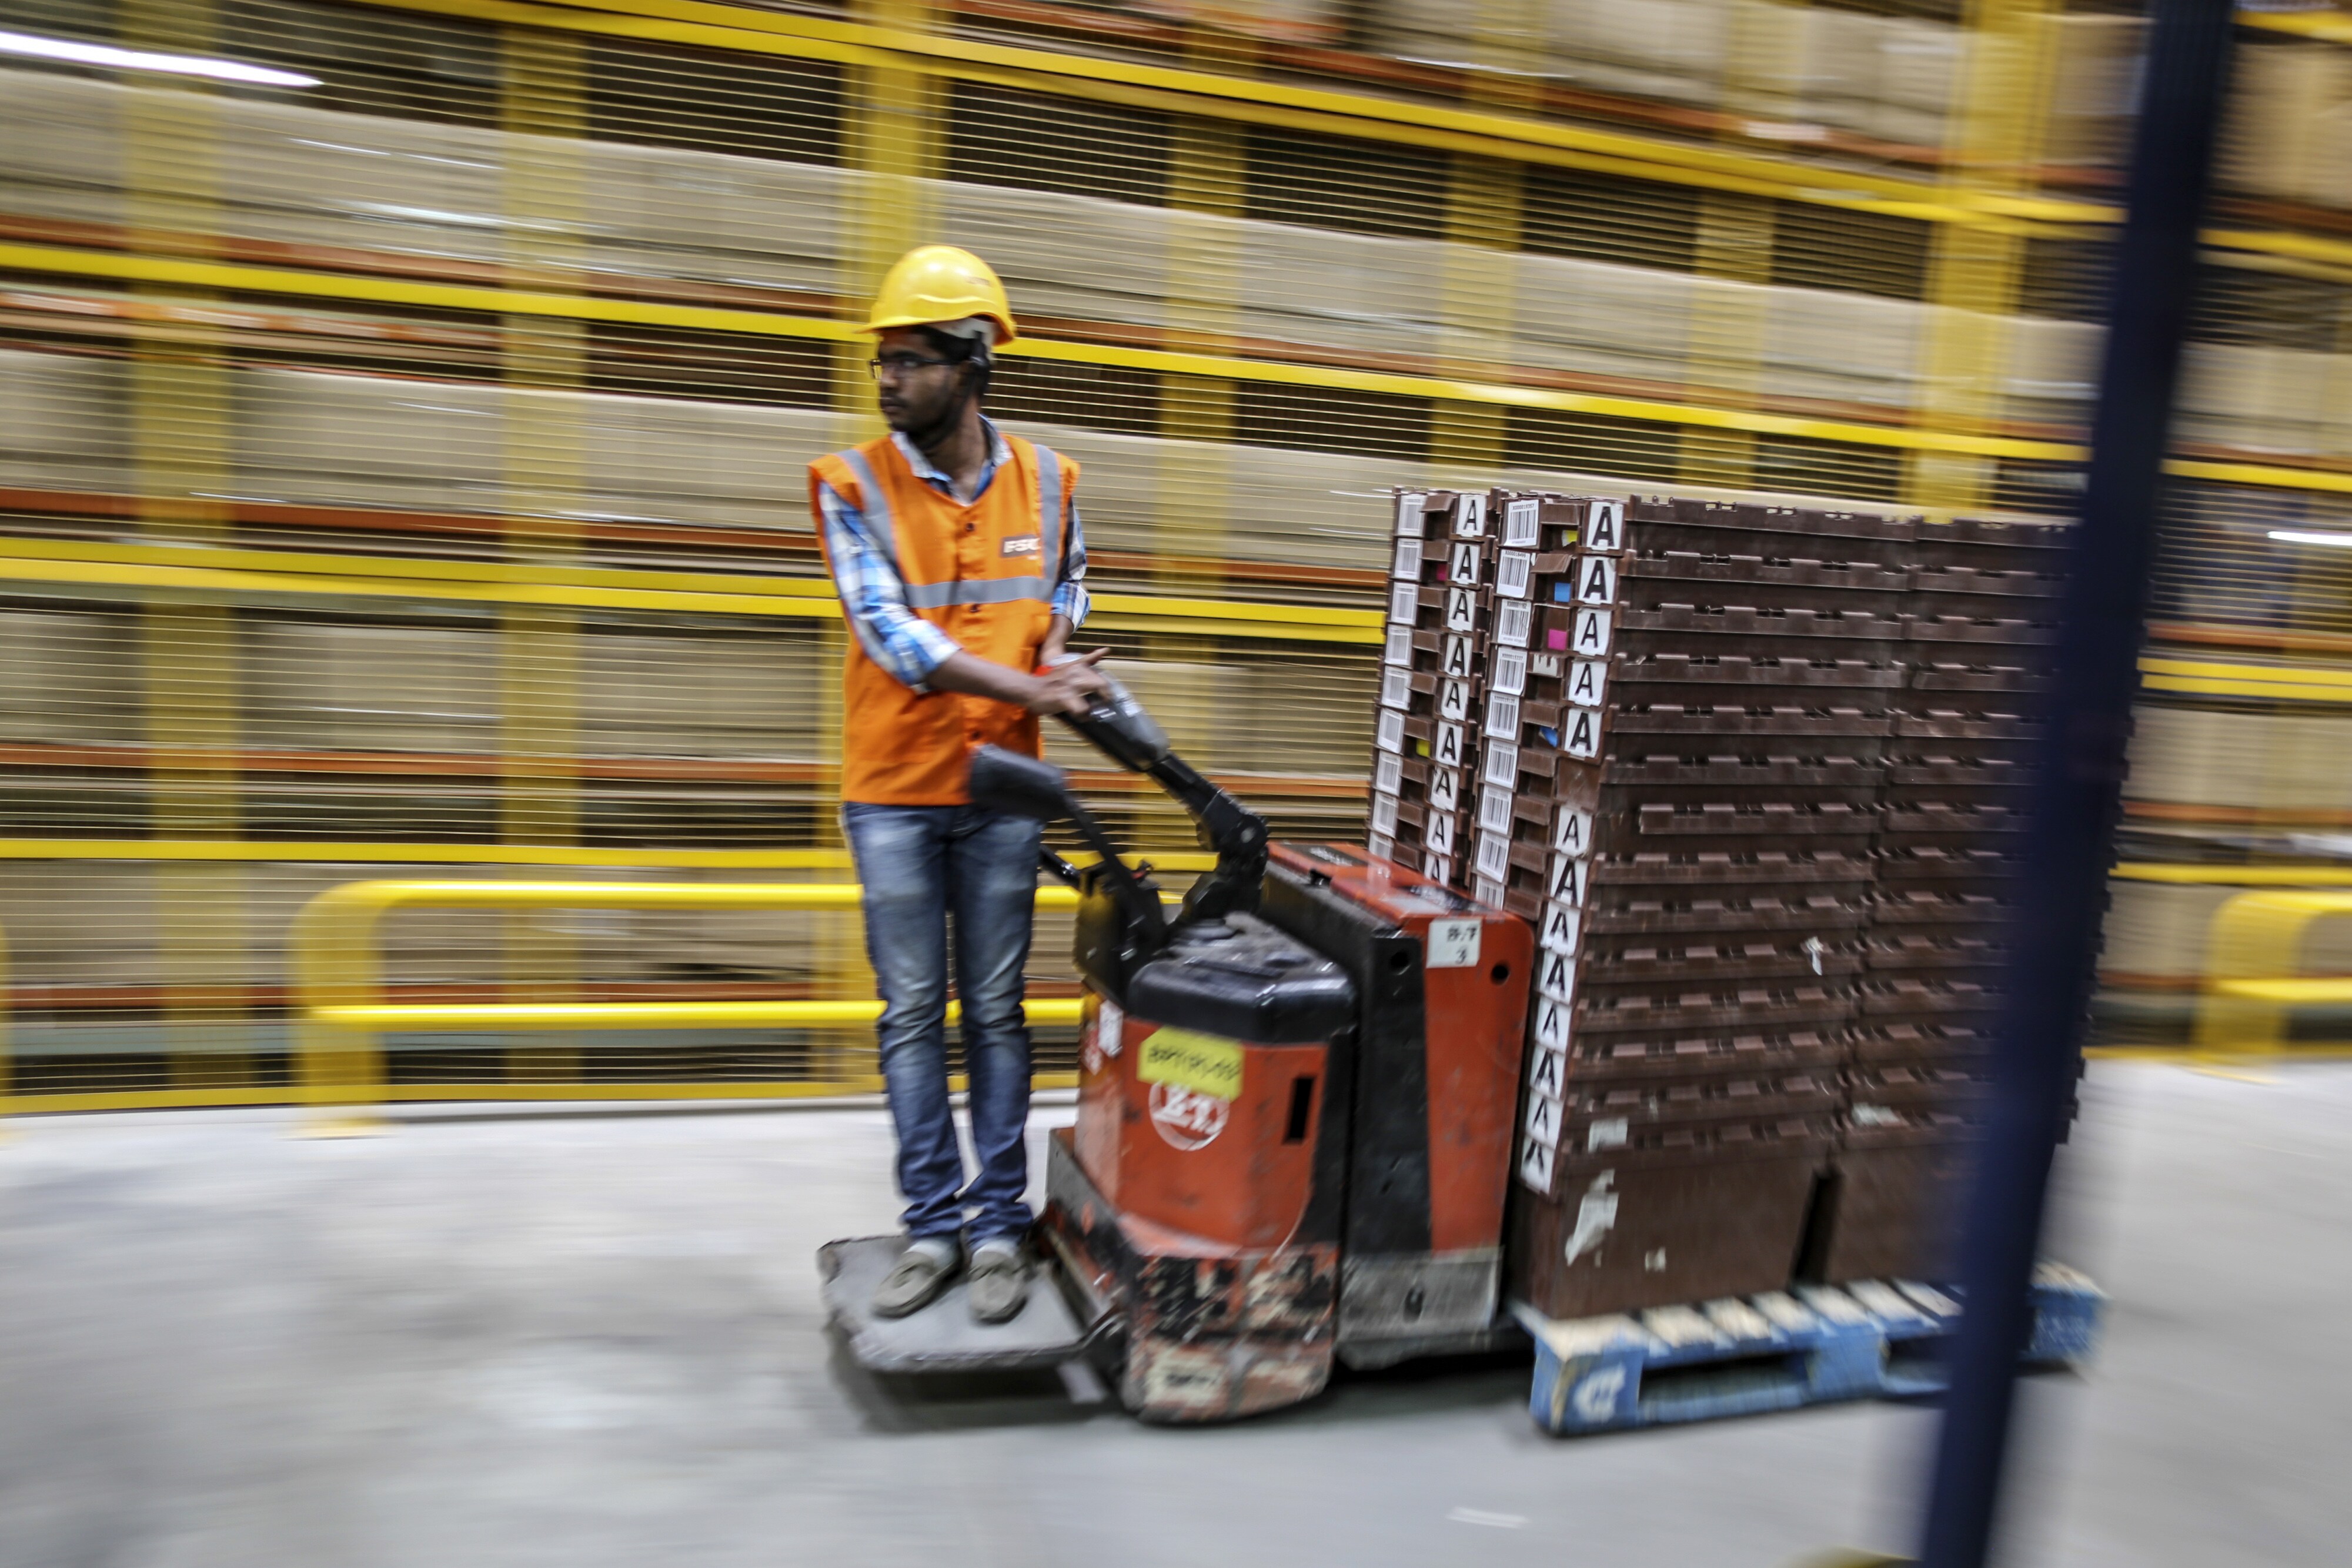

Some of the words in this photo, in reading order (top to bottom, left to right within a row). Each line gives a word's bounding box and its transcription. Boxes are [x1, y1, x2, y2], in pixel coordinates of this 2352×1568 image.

[1464, 500, 1477, 531] A
[1592, 506, 1614, 547] A
[1458, 545, 1472, 580] A
[1583, 559, 1607, 600] A
[1453, 592, 1469, 622] A
[1581, 613, 1598, 647] A
[1449, 637, 1465, 676] A
[1446, 682, 1461, 710] A
[1575, 663, 1593, 698] A
[1441, 726, 1456, 761] A
[1570, 711, 1592, 751] A
[1435, 770, 1453, 799] A
[1432, 815, 1445, 846] A
[1563, 814, 1579, 849] A
[1431, 858, 1440, 882] A
[1555, 858, 1578, 907] A
[1550, 908, 1568, 942] A
[1546, 955, 1566, 997] A
[1542, 1003, 1558, 1042] A
[1535, 1048, 1556, 1095] A
[1533, 1096, 1548, 1138] A
